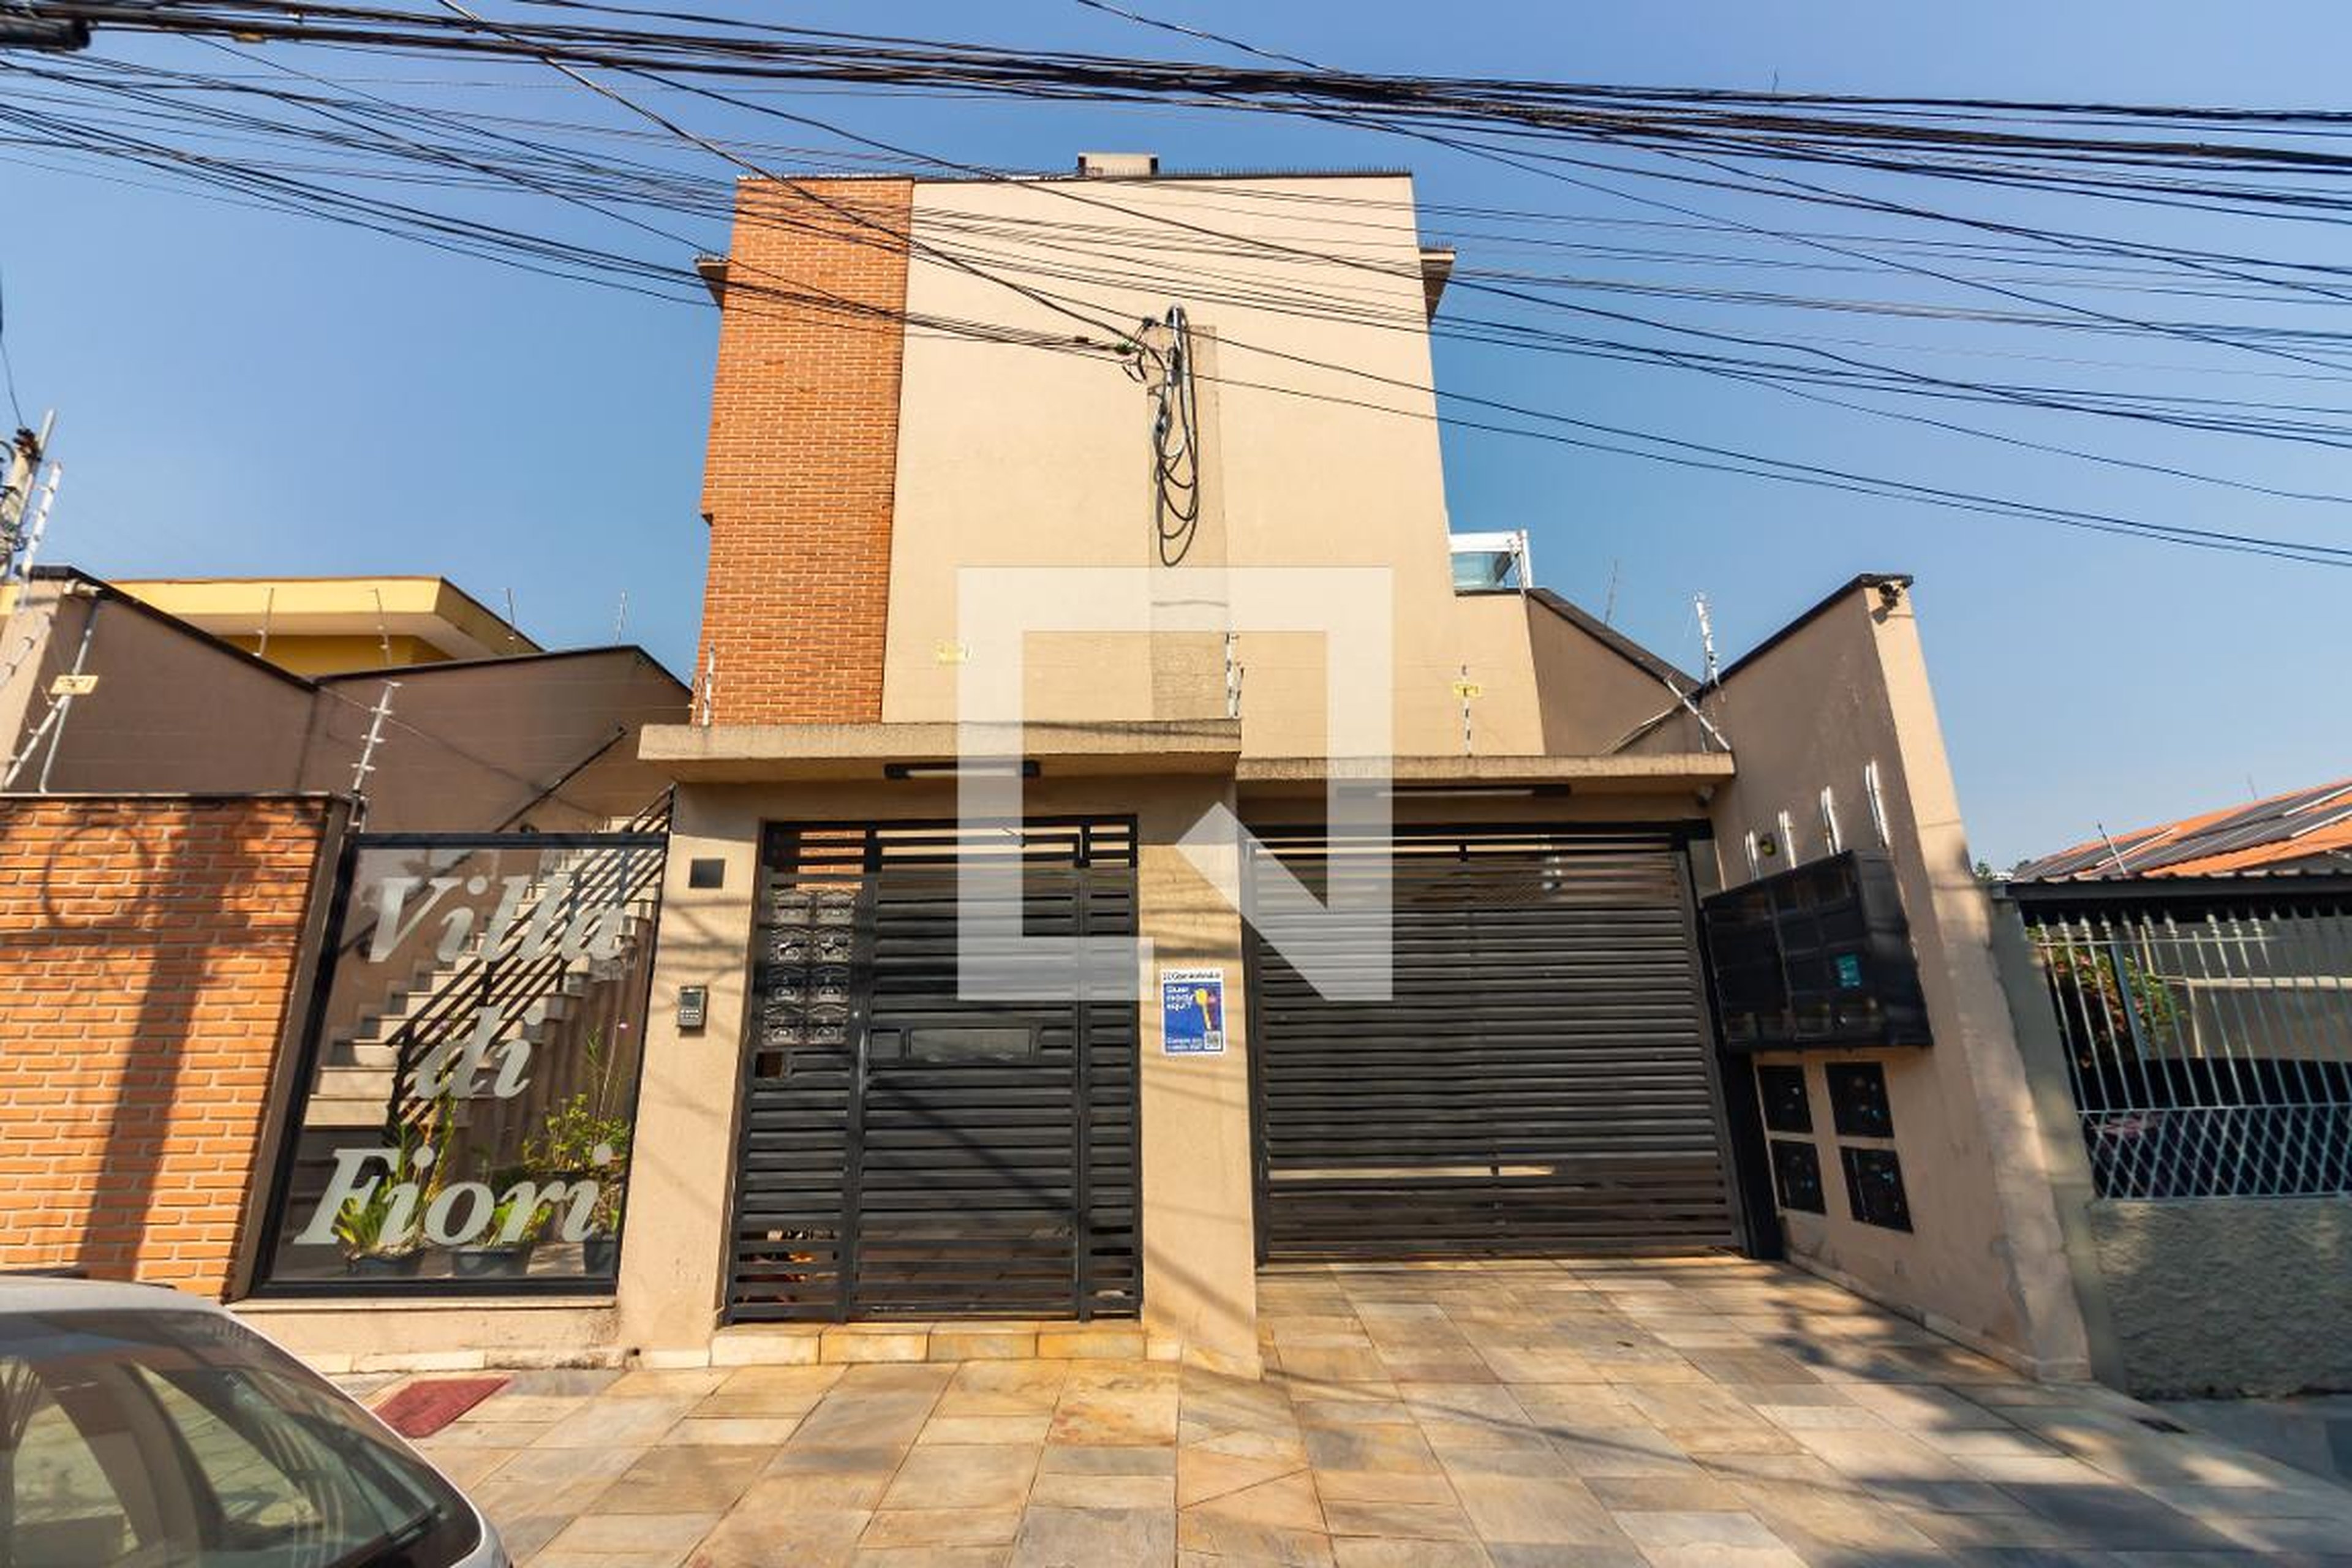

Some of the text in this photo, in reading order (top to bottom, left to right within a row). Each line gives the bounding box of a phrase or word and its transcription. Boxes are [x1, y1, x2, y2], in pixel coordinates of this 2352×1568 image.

[369, 875, 625, 962] Villa
[412, 1005, 546, 1098] di
[293, 1143, 614, 1246] Fiori
